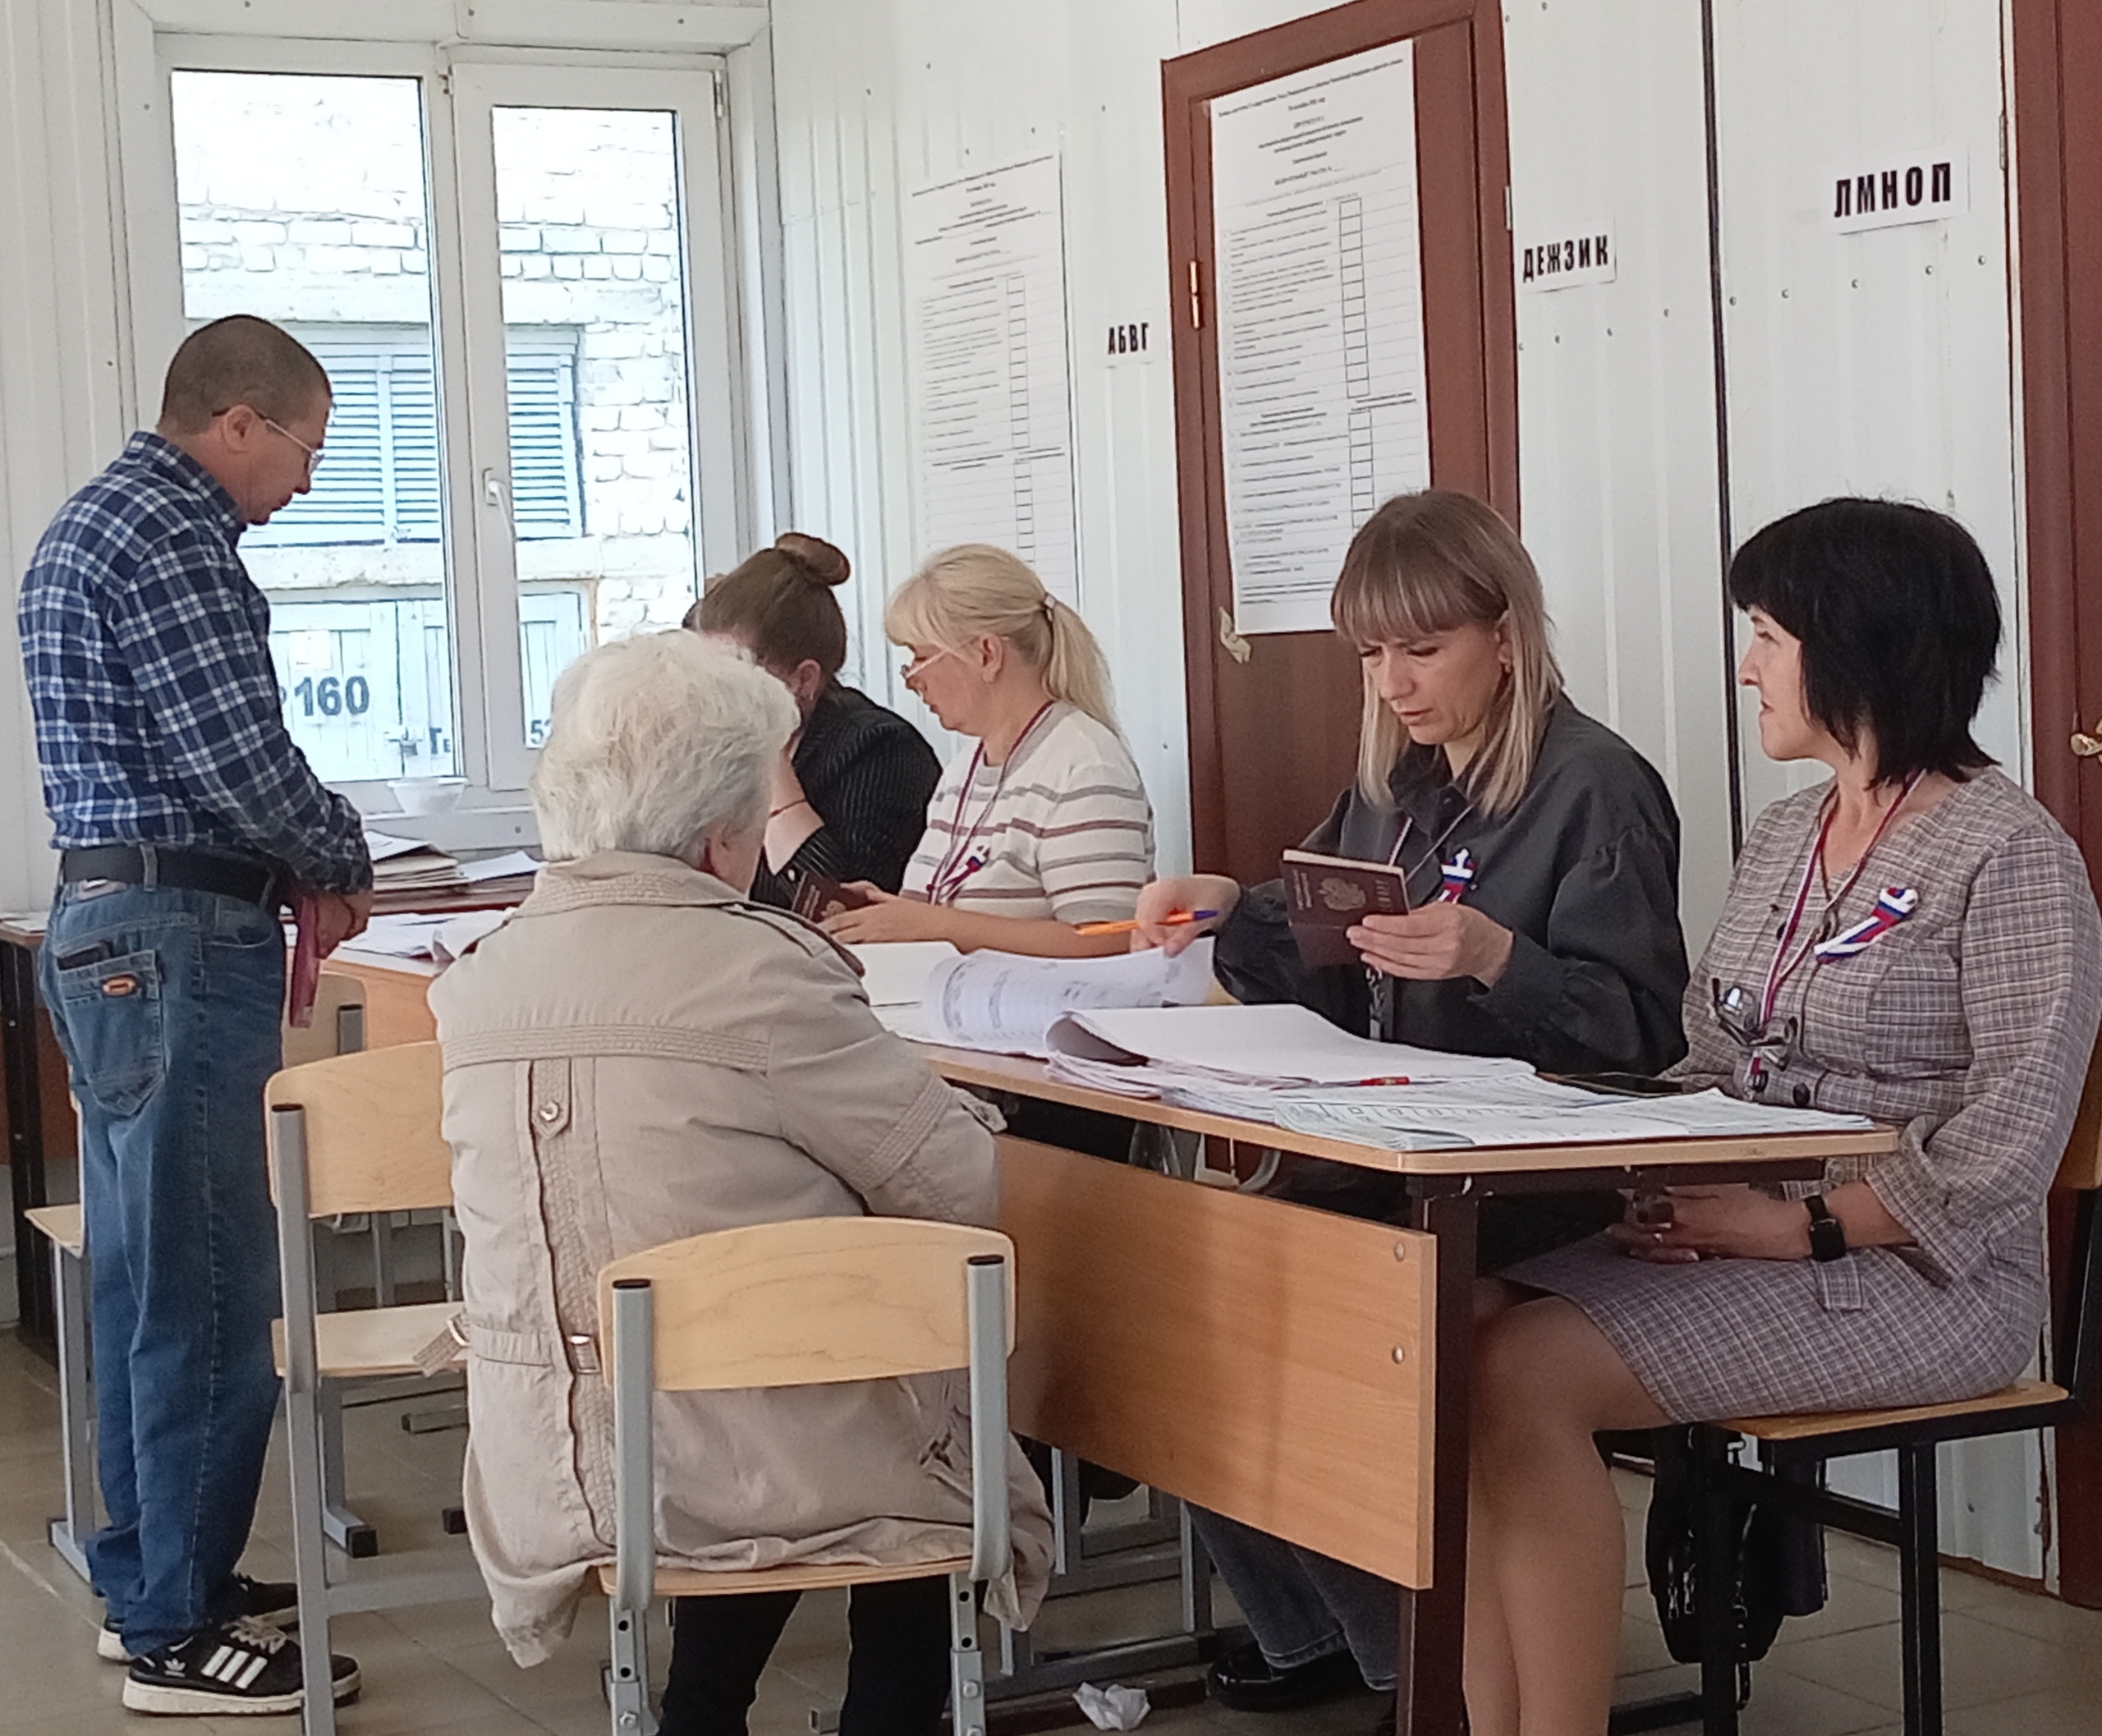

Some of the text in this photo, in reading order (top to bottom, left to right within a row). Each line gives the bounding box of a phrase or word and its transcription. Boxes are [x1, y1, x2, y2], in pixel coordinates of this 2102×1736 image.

[1834, 162, 1951, 218] ЛМНОП
[1522, 234, 1609, 283] ДЕЖЗИК
[1108, 322, 1149, 356] АБВГ
